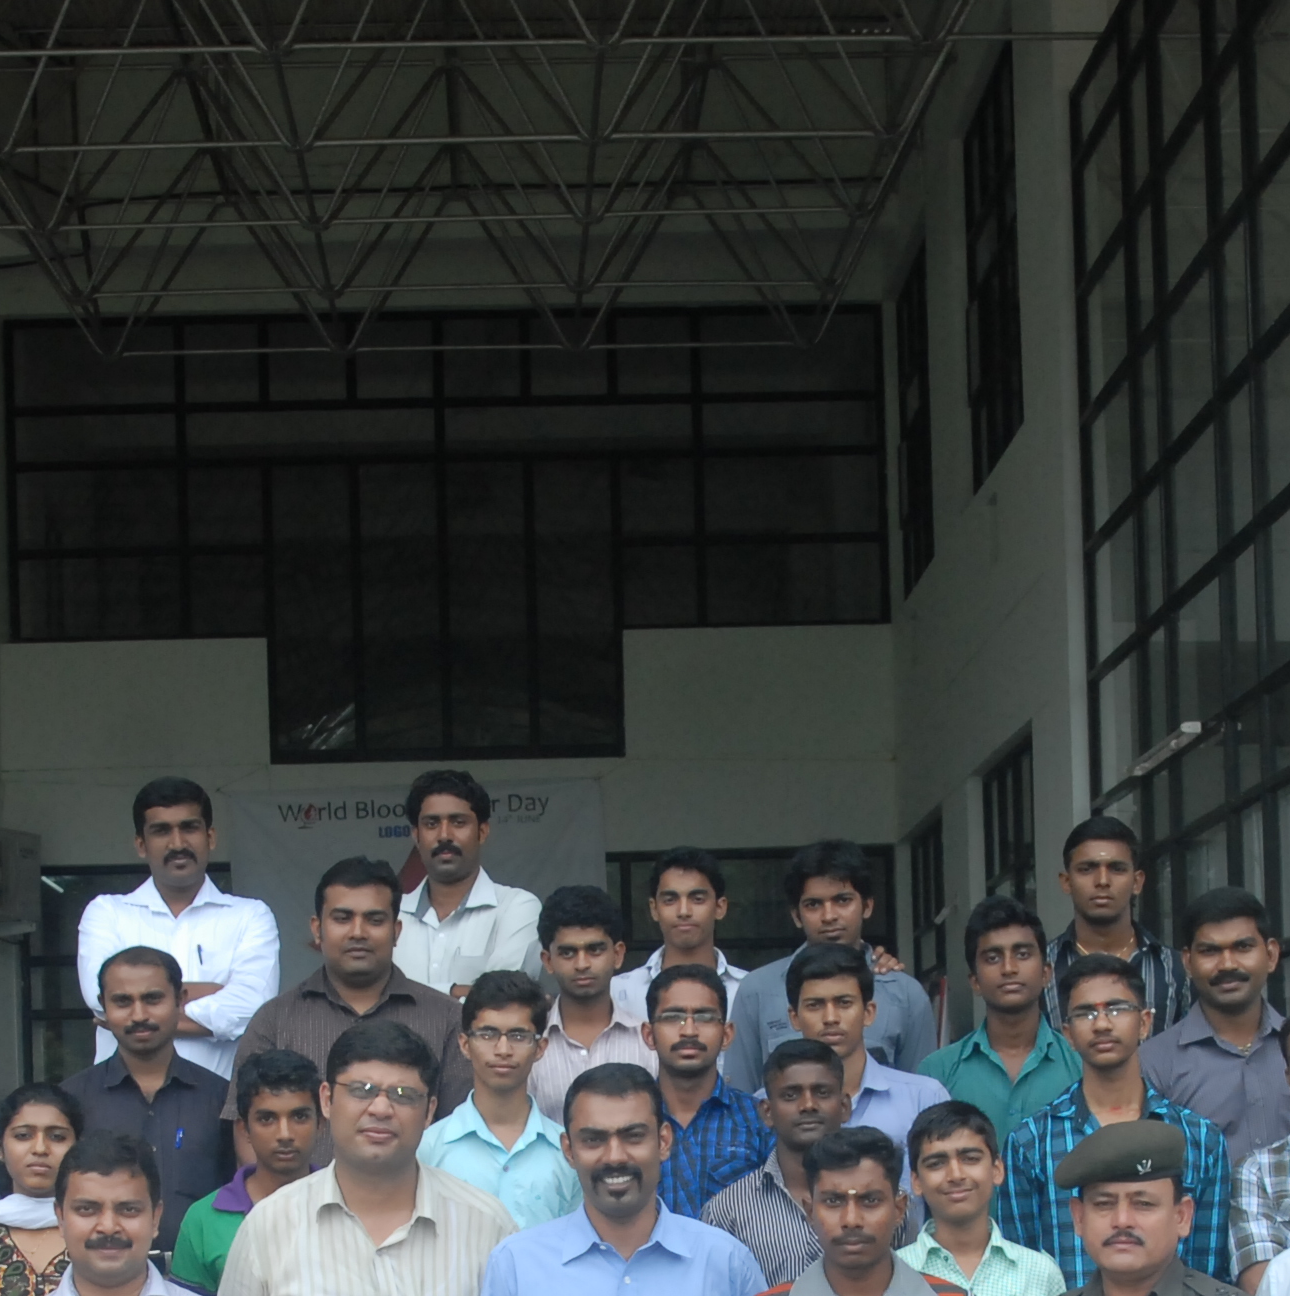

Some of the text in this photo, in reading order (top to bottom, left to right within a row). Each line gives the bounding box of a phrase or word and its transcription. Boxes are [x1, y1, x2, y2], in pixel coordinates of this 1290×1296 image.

[277, 801, 348, 822] World
[355, 800, 407, 820] Bloo
[507, 793, 549, 816] Day
[378, 825, 411, 838] LOGO
